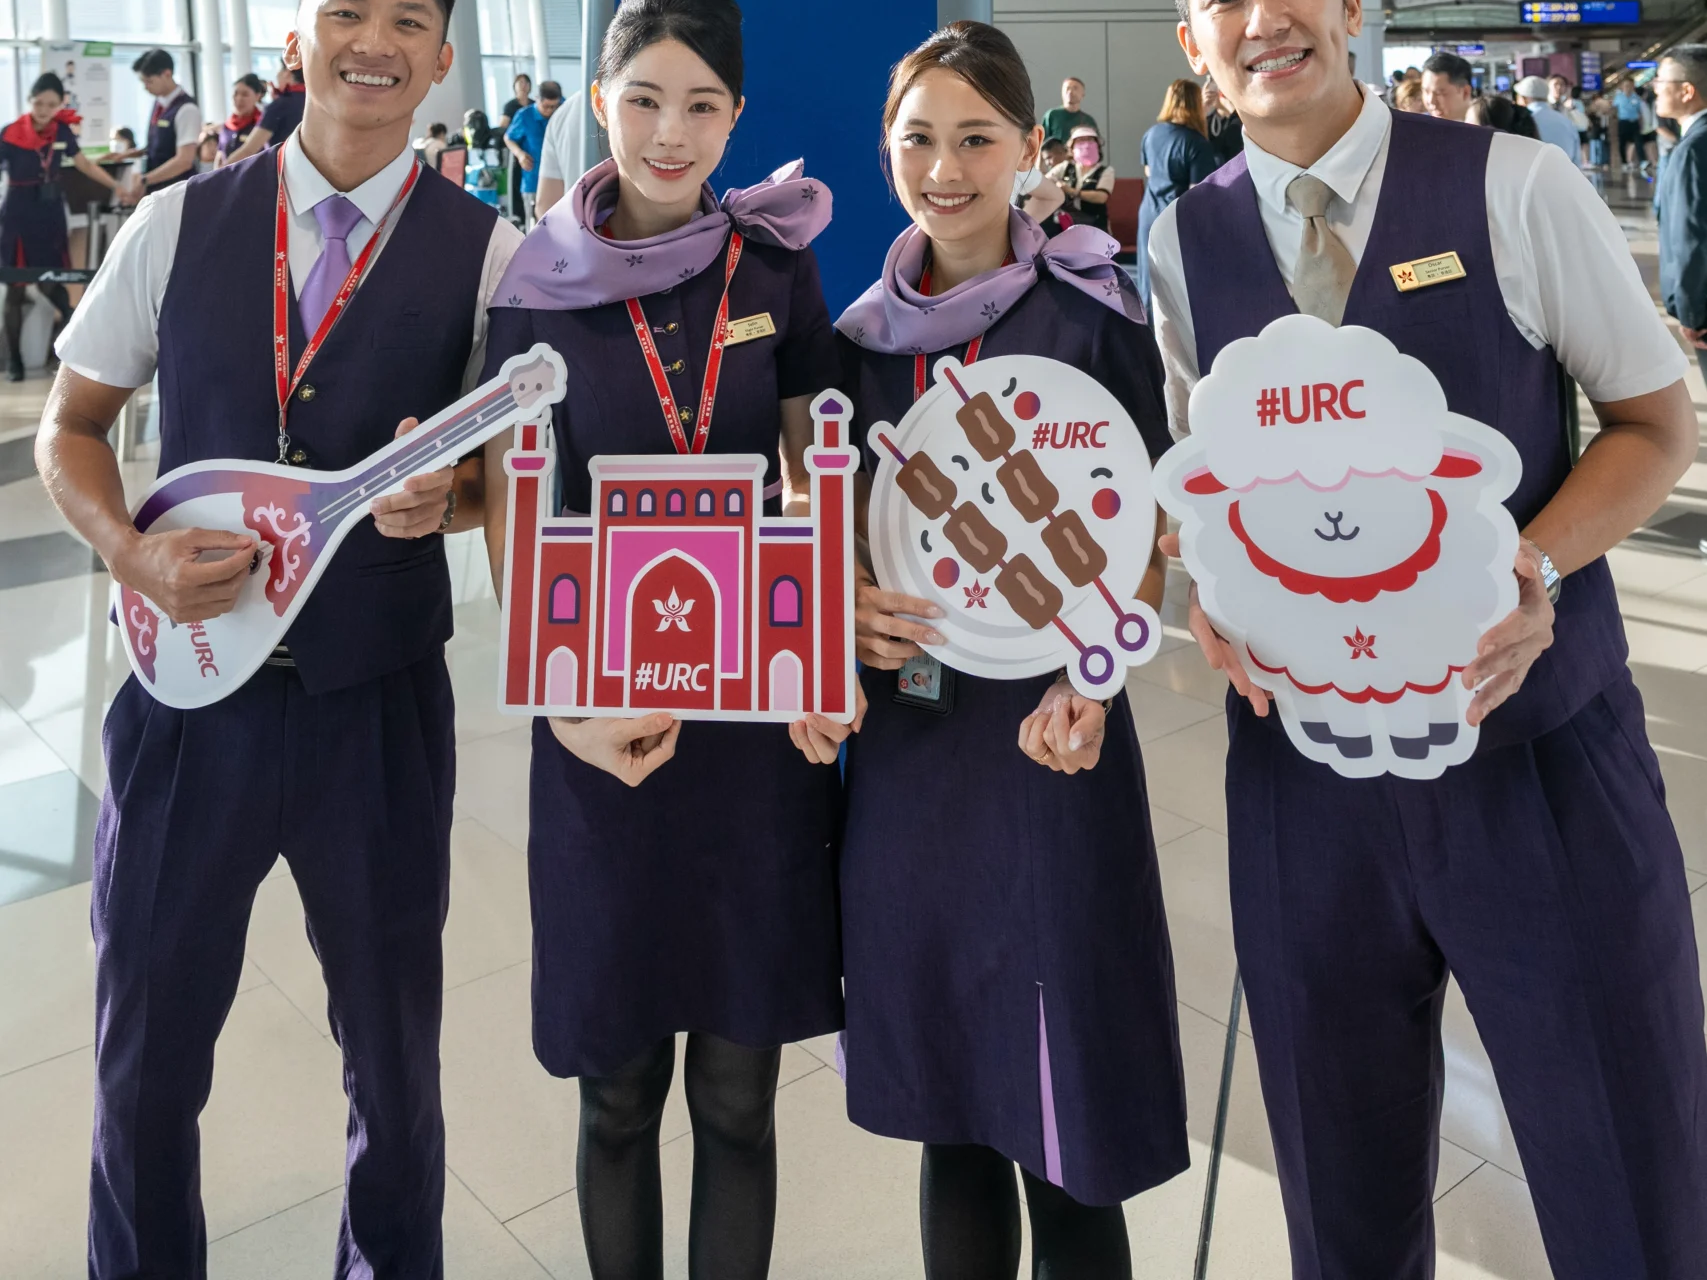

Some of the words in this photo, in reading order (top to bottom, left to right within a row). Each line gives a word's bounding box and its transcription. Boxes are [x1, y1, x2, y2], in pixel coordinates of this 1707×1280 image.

[1256, 379, 1366, 427] #URC
[1032, 421, 1110, 450] #URC
[186, 619, 219, 678] #URC
[635, 662, 710, 692] #URC
